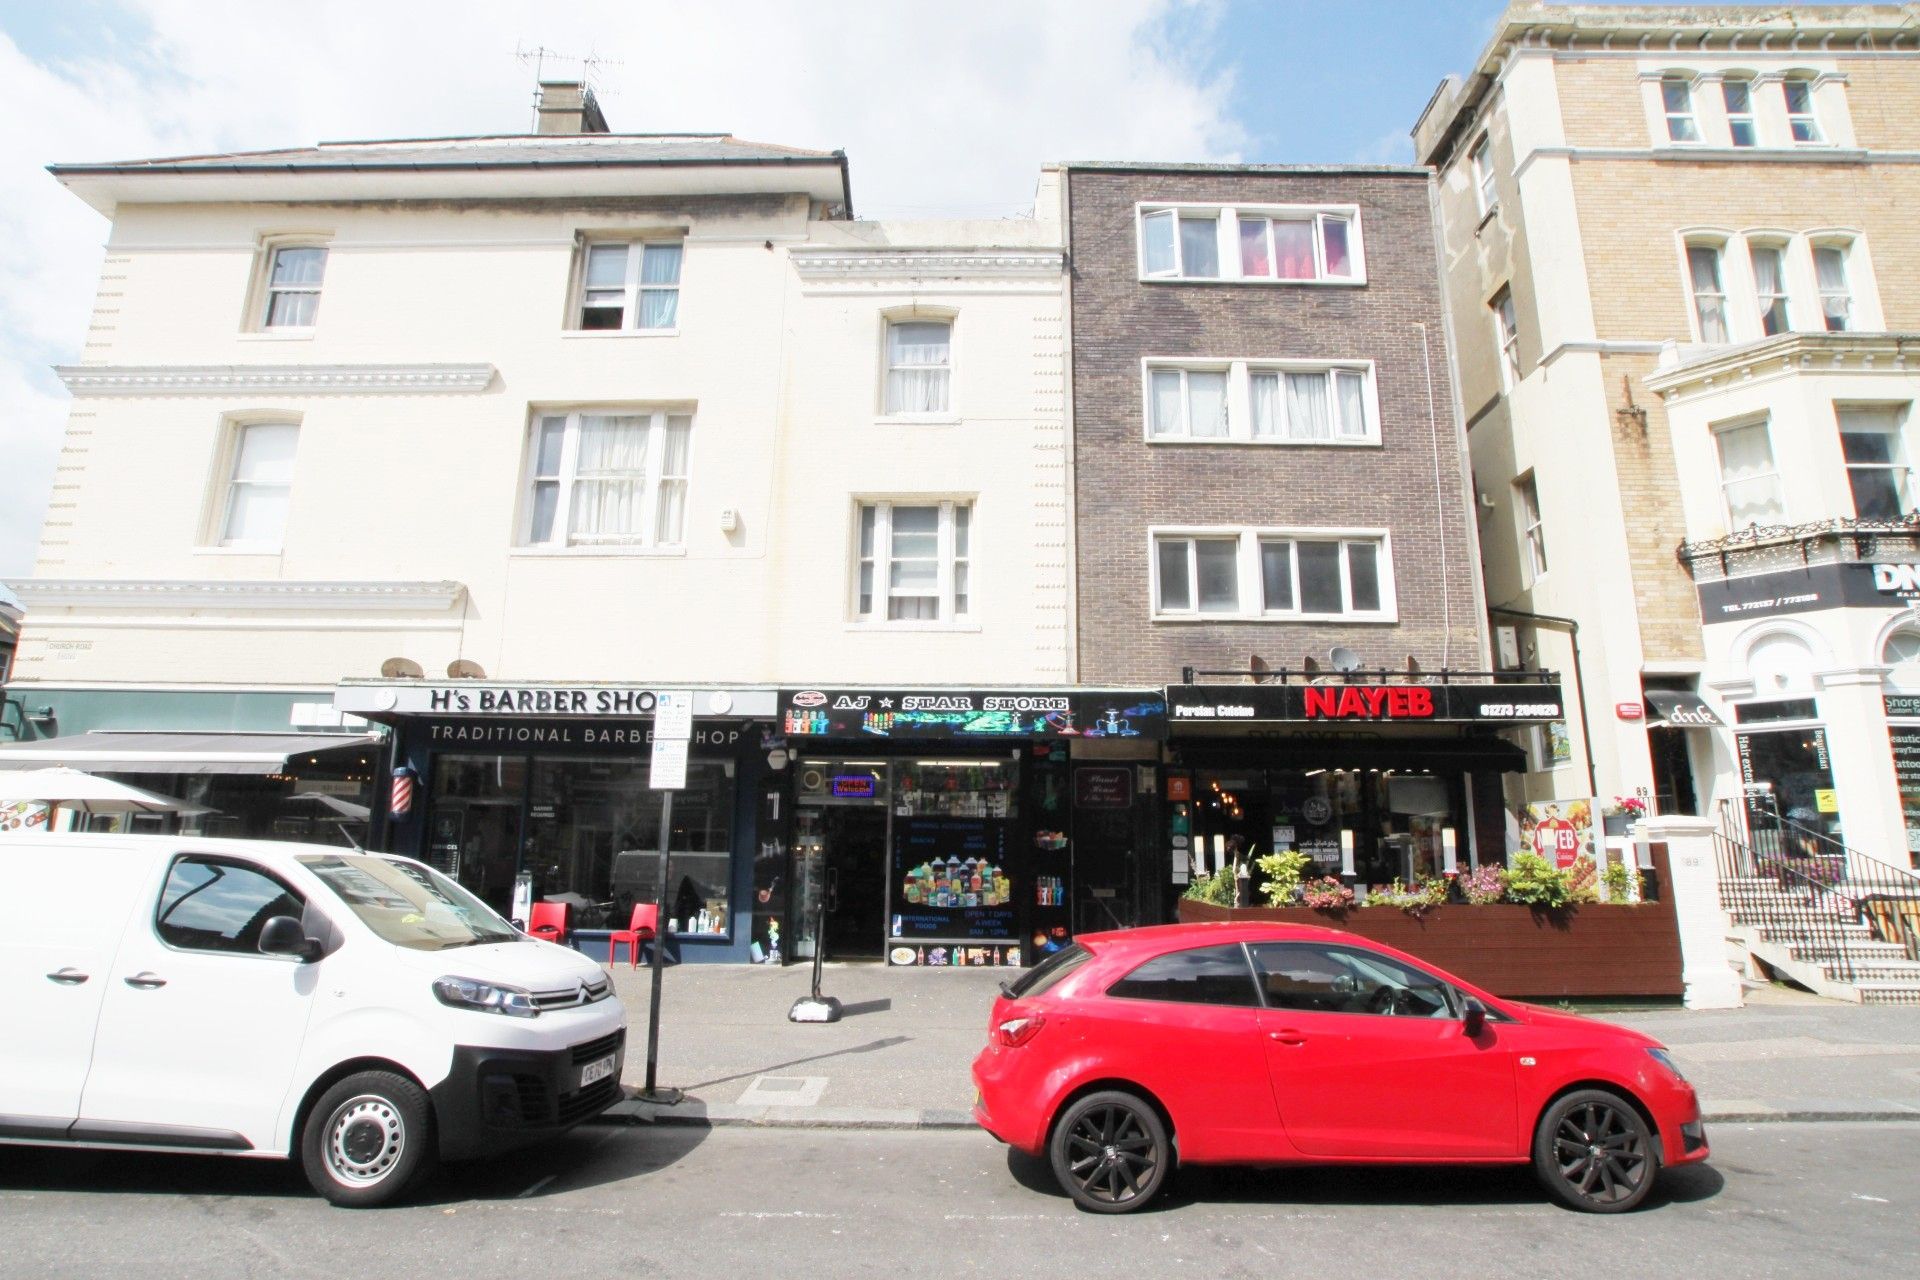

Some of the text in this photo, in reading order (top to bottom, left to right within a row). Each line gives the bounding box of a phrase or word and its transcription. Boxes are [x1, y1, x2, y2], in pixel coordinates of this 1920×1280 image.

[431, 689, 469, 711] H's
[480, 690, 587, 711] BARBER
[597, 690, 657, 713] SHO
[833, 696, 871, 710] AJ
[901, 695, 973, 711] STAR
[983, 696, 1069, 711] STORE
[1304, 686, 1434, 718] NAYEB
[1480, 704, 1513, 716] 01273
[1175, 705, 1254, 717] Persian Cuisine
[431, 725, 740, 744] TRADITIONAL BARBE HOP
[1890, 734, 1920, 743] eautic
[1738, 736, 1751, 757] Hair
[1814, 730, 1829, 770] Beautician
